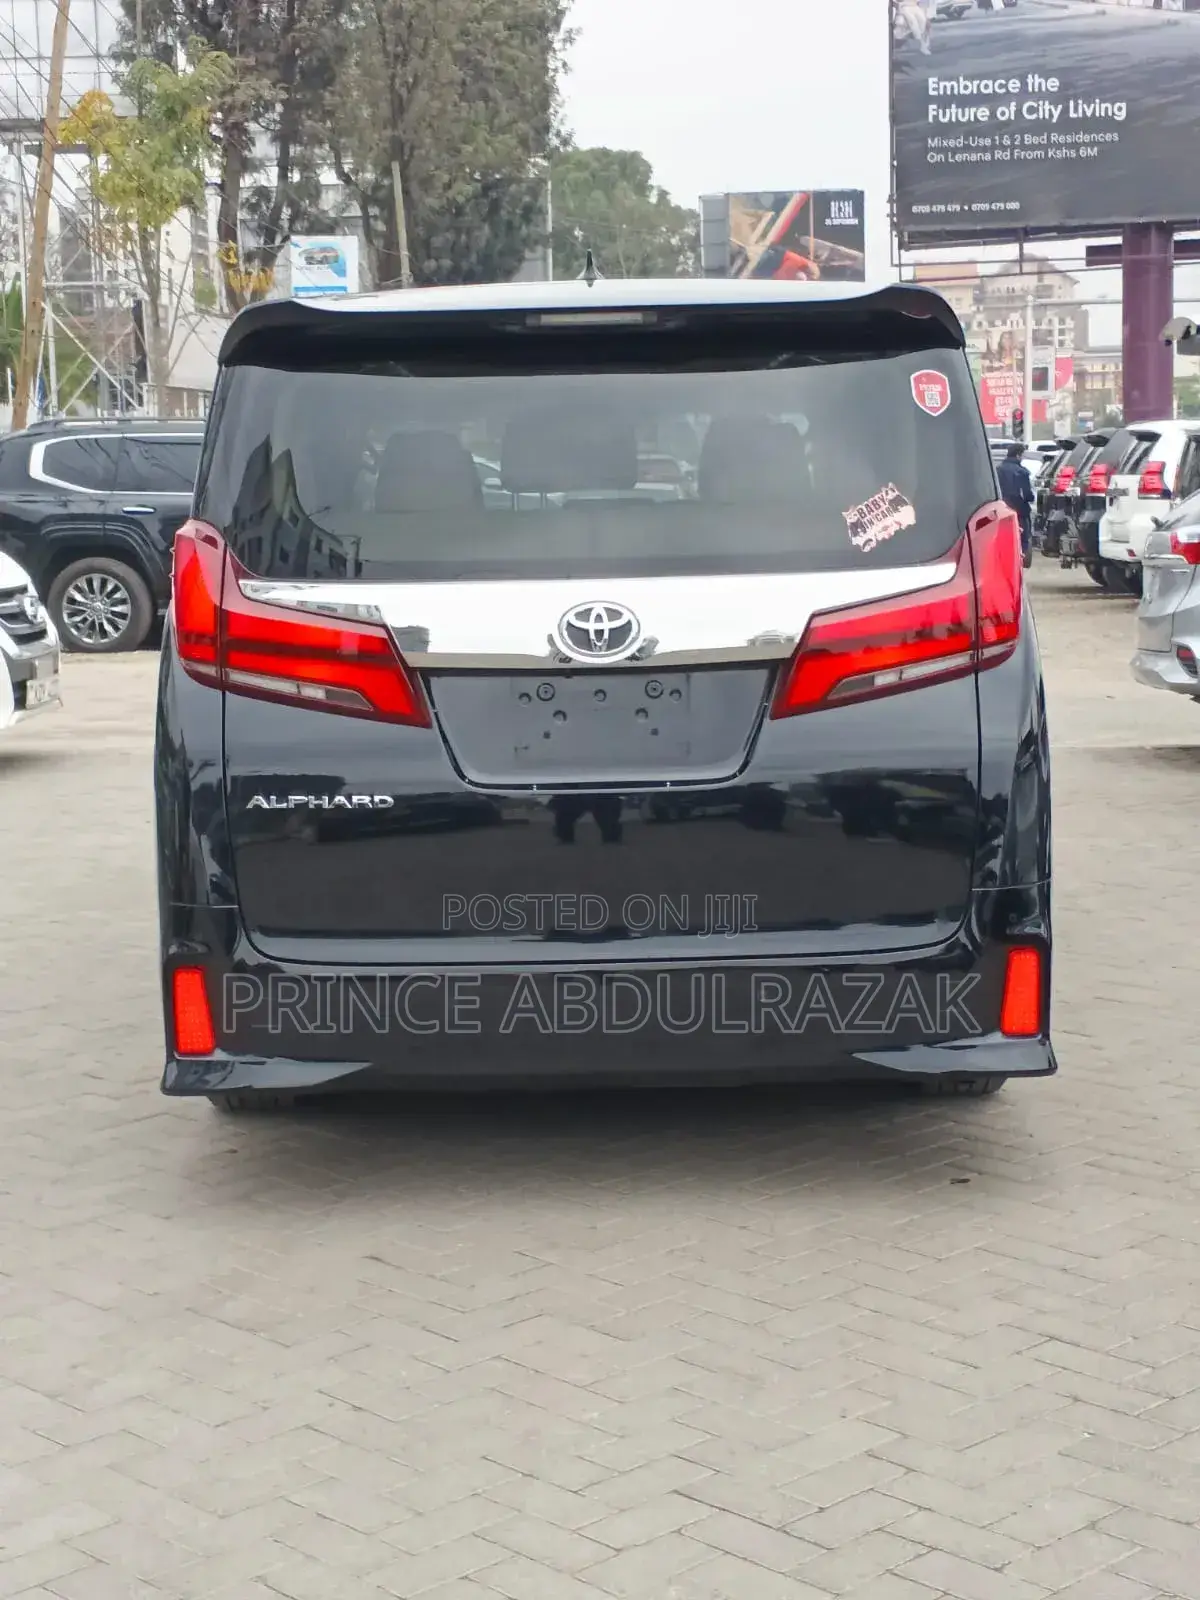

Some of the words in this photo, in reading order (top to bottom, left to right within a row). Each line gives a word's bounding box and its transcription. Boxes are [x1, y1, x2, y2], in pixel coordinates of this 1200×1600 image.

[928, 76, 1021, 96] Embrace
[1026, 74, 1060, 93] the
[928, 103, 990, 123] Future
[996, 101, 1017, 121] of
[1022, 100, 1063, 123] City
[1069, 98, 1127, 121] Living
[927, 135, 992, 148] Mixed-Use
[994, 136, 1000, 146] 1
[1002, 135, 1011, 146] &
[1014, 134, 1021, 145] 2
[1024, 132, 1048, 145] Bed
[1050, 131, 1119, 144] Residences
[927, 152, 945, 163] On
[948, 150, 992, 162] Lenana
[994, 149, 1011, 161] Rd
[1014, 149, 1045, 160] From
[1048, 147, 1077, 159] Kshs
[1079, 146, 1098, 157] 6M
[856, 494, 887, 519] BABY
[246, 795, 395, 809] ALPHARD
